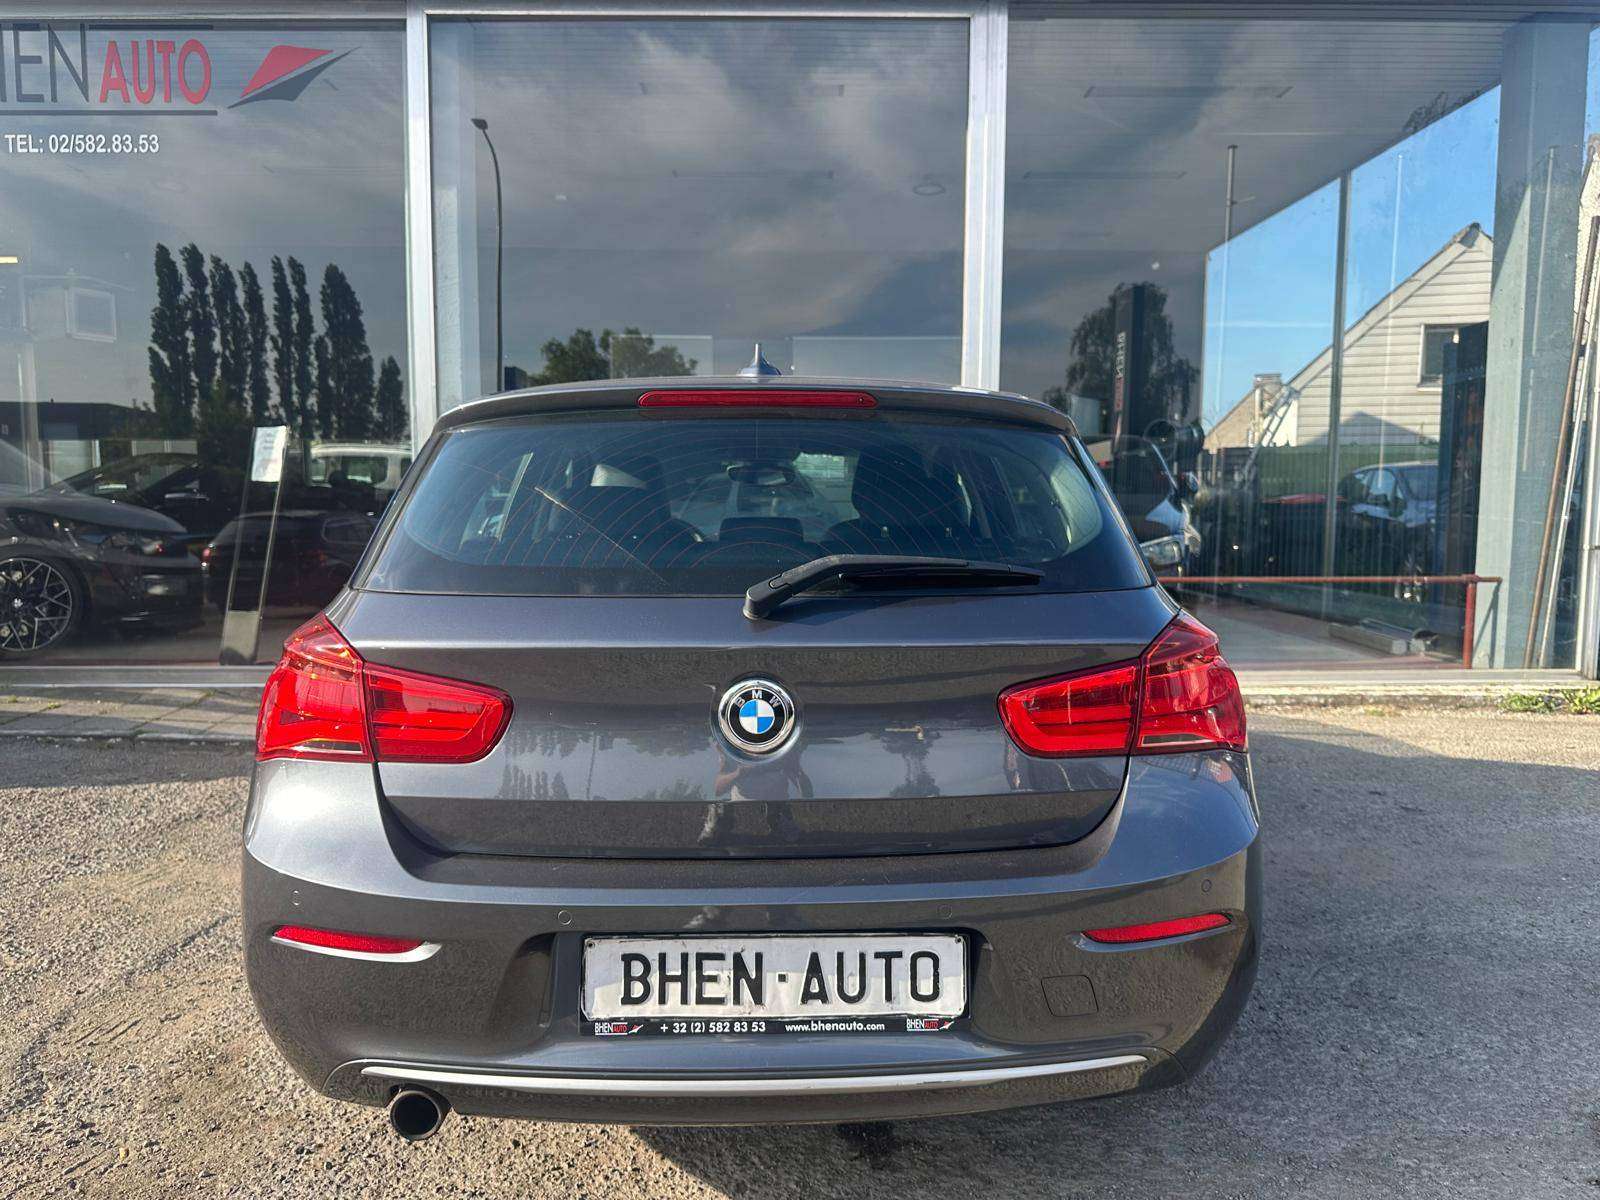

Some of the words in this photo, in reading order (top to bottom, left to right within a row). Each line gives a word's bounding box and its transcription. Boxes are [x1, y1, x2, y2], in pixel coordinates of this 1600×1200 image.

[0, 23, 90, 103] EN
[99, 38, 212, 105] AUTO
[4, 133, 44, 154] TEL:
[48, 133, 160, 154] 02/582.83.53
[735, 689, 781, 708] BMW
[620, 951, 764, 1006] BHEN
[800, 950, 940, 1004] AUTO
[673, 1022, 687, 1033] 32
[691, 1021, 705, 1033] (2)
[709, 1021, 730, 1032] 582
[734, 1021, 748, 1032] 83
[751, 1021, 766, 1032] 53
[785, 1020, 885, 1032] www.bhenauto.com
